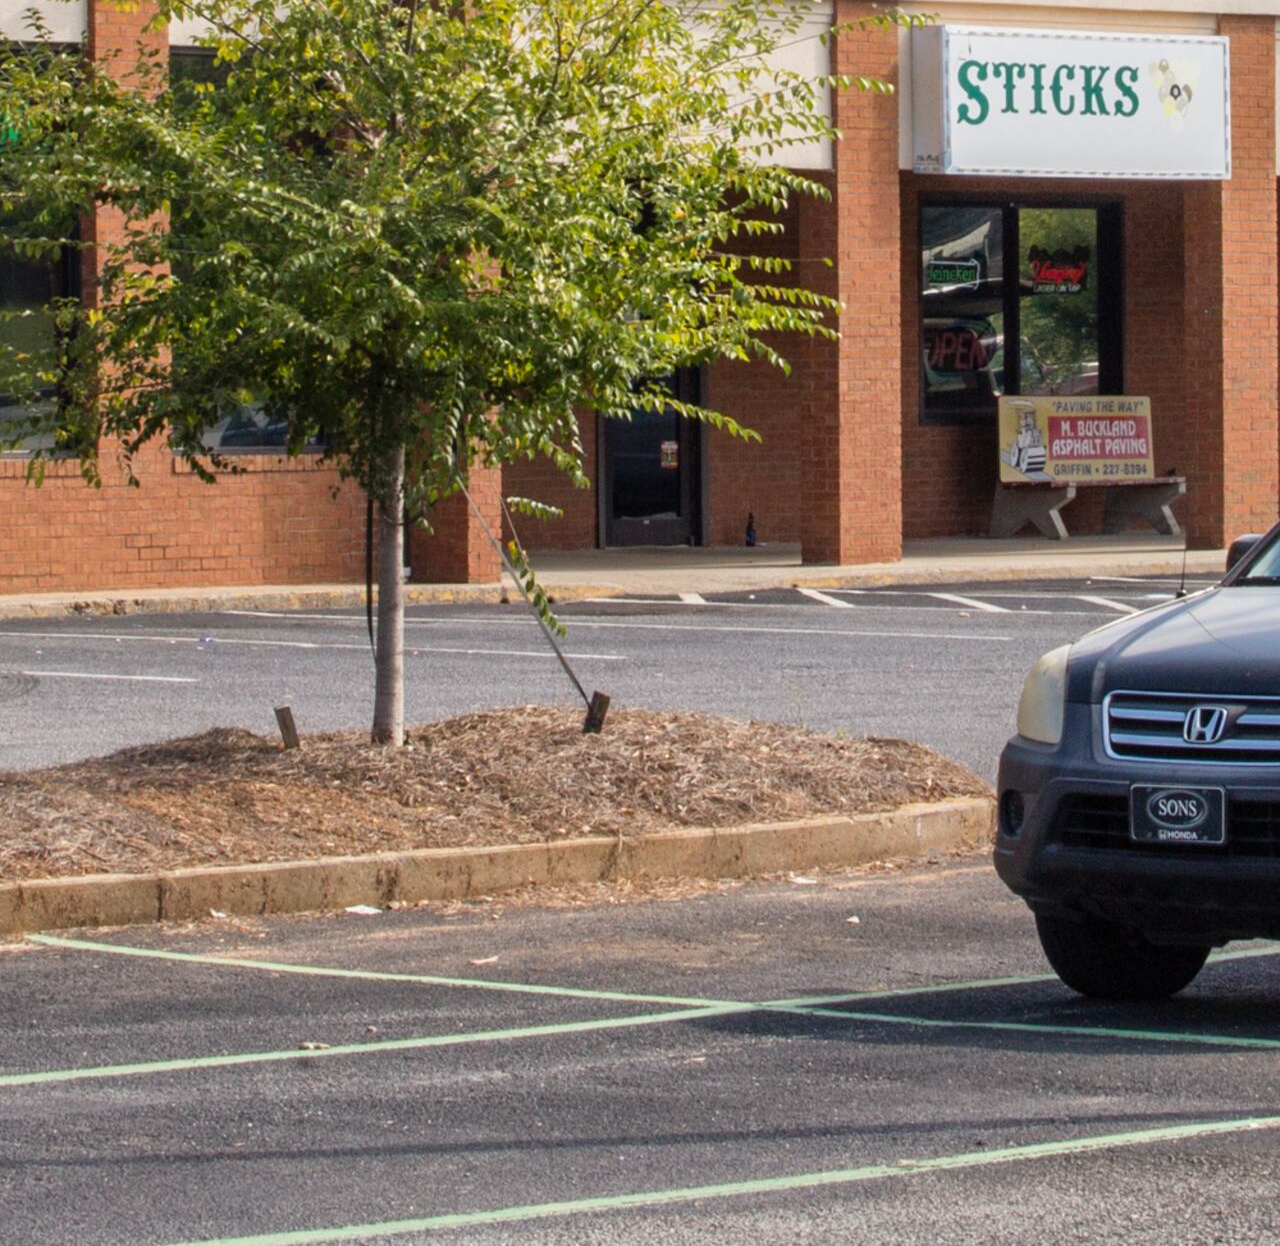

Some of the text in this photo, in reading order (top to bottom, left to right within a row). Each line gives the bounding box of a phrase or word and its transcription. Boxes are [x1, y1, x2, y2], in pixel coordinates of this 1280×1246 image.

[957, 60, 1140, 125] STICKS
[1096, 401, 1114, 412] THE
[1061, 420, 1136, 436] M. BUCKLAND
[1052, 439, 1147, 456] ASPHALT PAVING
[1053, 463, 1091, 475] GRIFFIN
[1158, 799, 1197, 817] SONS
[1167, 831, 1198, 840] HONDA
